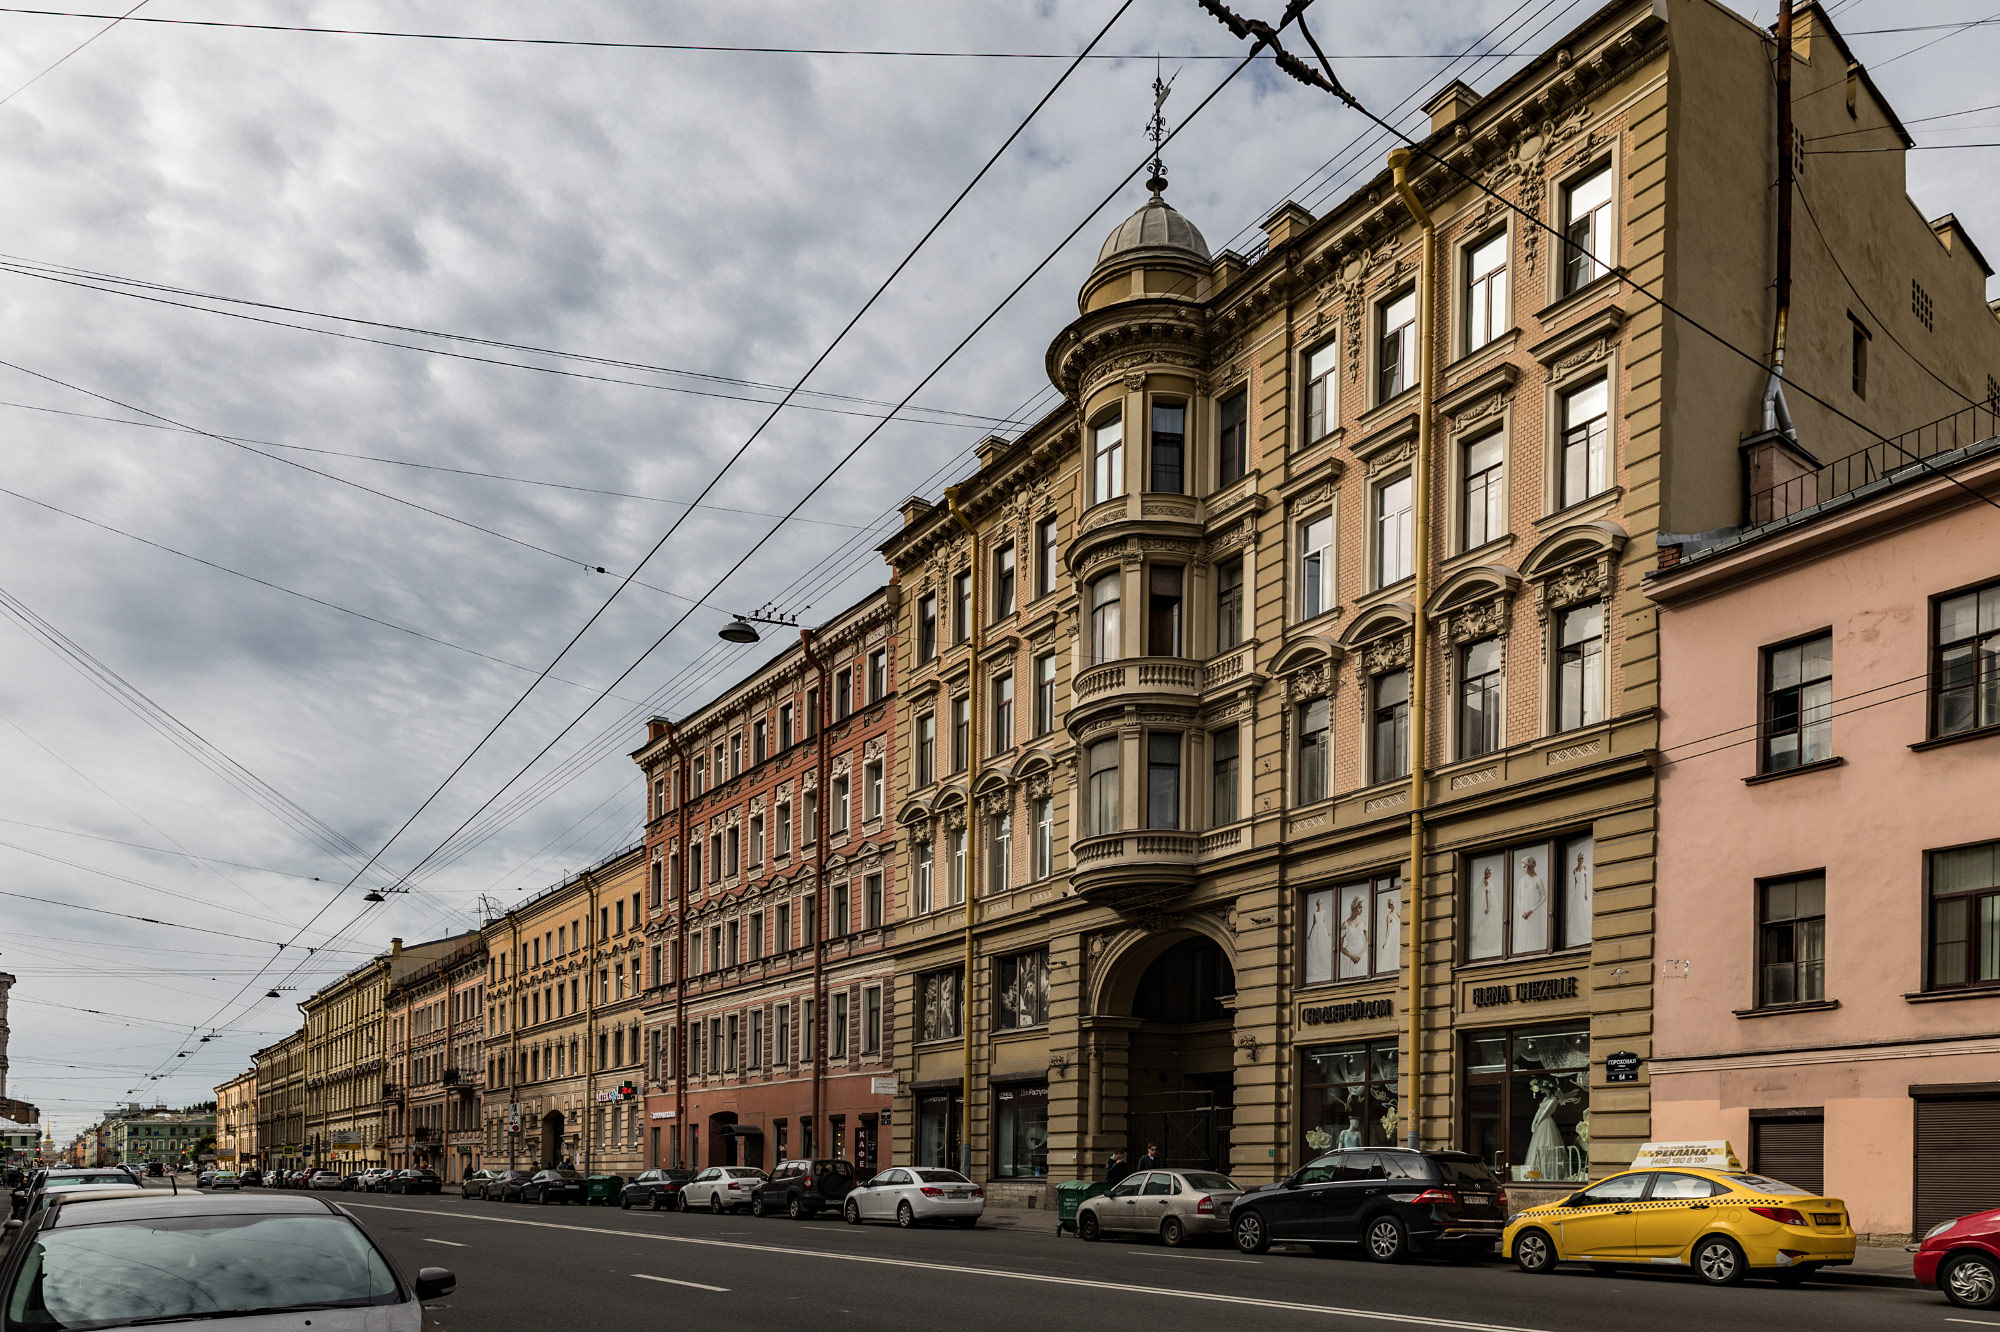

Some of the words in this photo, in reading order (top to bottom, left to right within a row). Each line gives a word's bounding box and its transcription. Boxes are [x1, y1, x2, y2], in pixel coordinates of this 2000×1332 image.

[1473, 985, 1510, 1006] ELENA
[1302, 1000, 1363, 1024] СВАДЕБНЫЙ
[1364, 999, 1393, 1018] ДОМ
[1655, 1148, 1707, 1158] РЕКЛАМА
